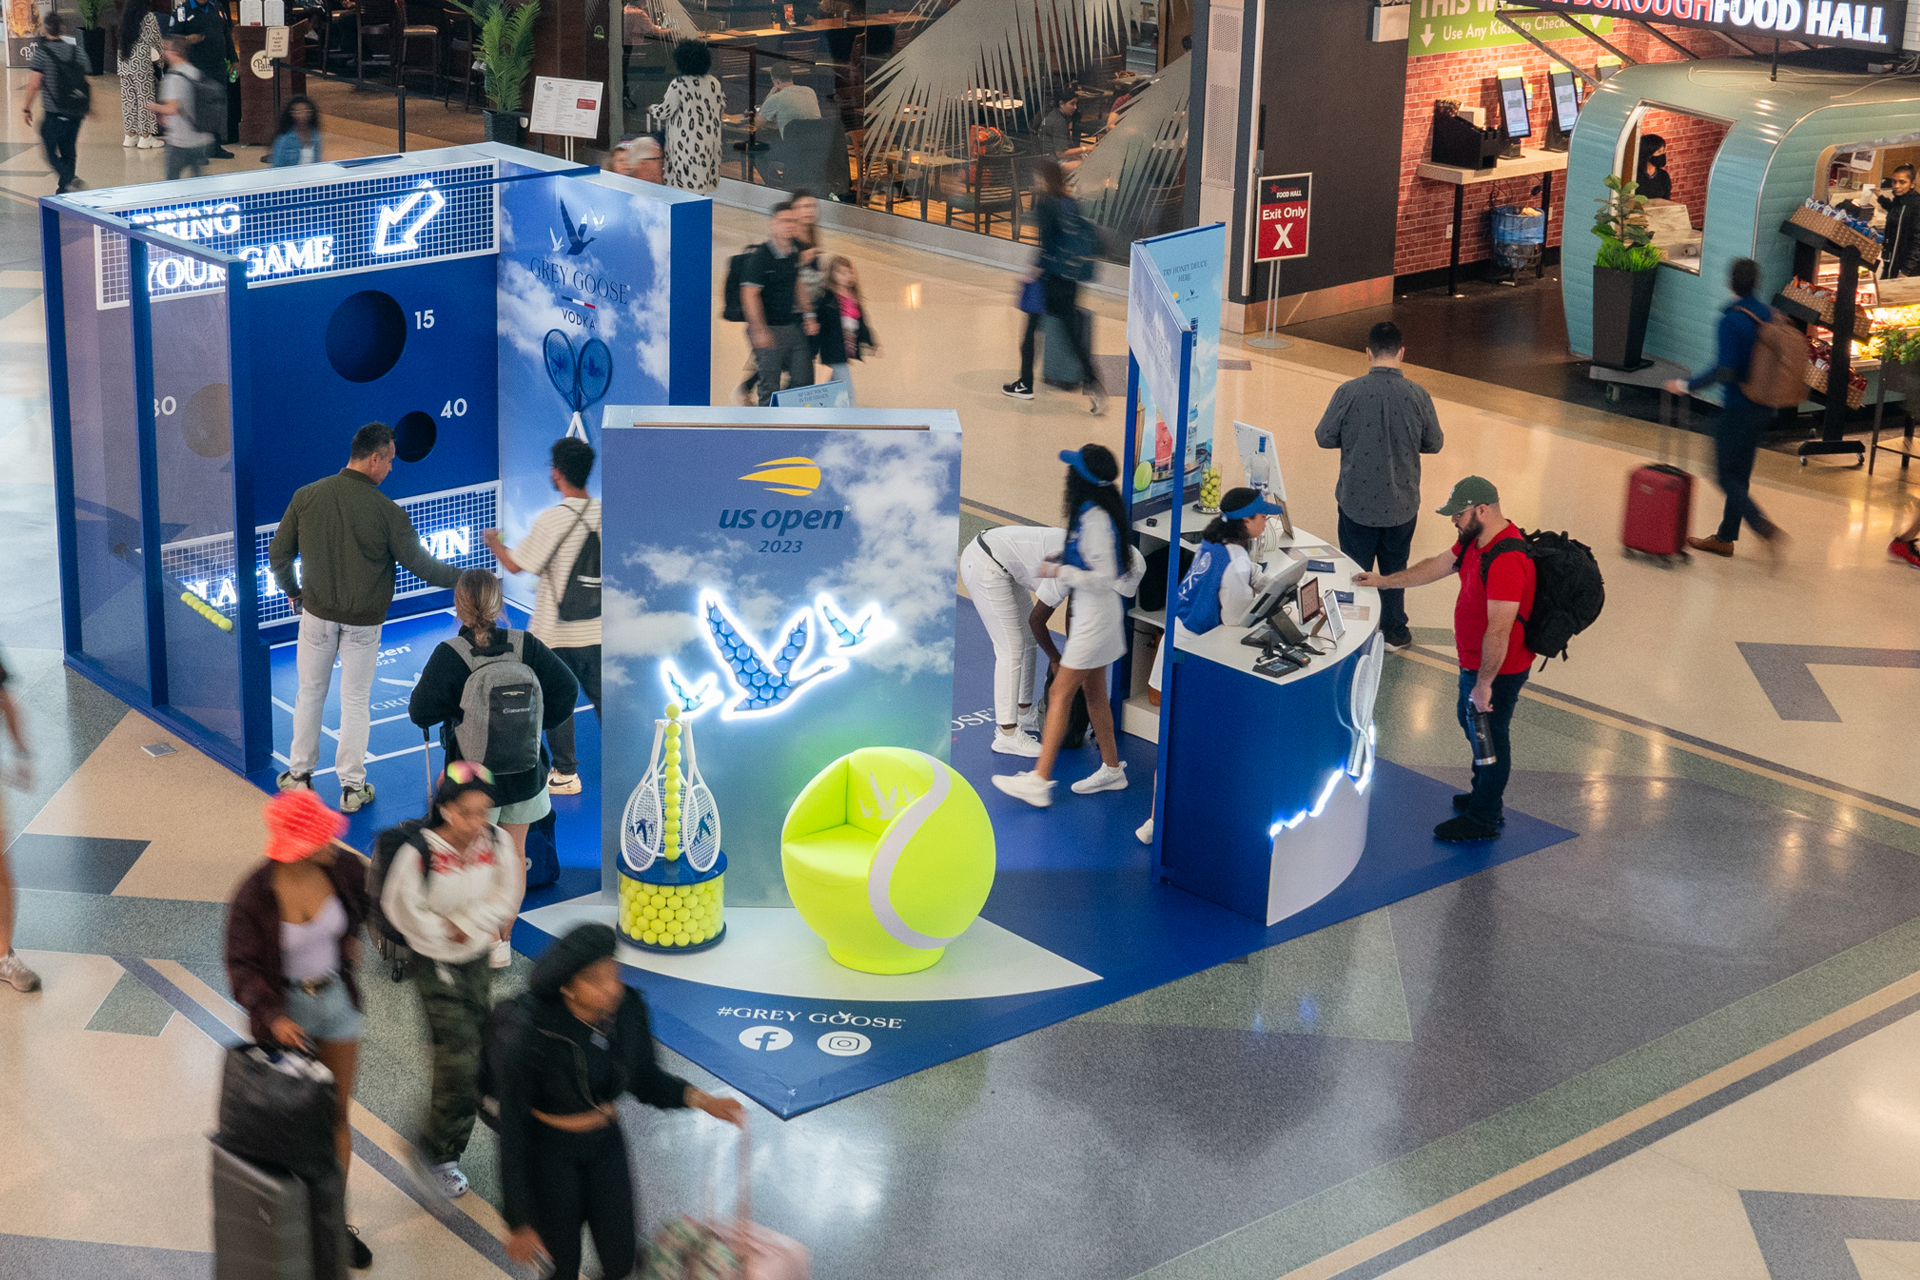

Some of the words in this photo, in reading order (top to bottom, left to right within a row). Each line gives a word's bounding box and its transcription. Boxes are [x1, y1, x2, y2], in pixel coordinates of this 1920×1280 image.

[1443, 25, 1463, 41] Use
[1465, 23, 1487, 41] Any
[1489, 19, 1516, 36] Kios
[1714, 0, 1801, 32] FOOD
[1805, 1, 1888, 44] HALL
[1276, 191, 1290, 199] FOOD
[1290, 190, 1302, 198] HALL
[132, 203, 241, 241] RING
[1262, 208, 1282, 221] Exit
[1283, 206, 1307, 219] Only
[238, 235, 334, 278] GAME
[1172, 263, 1190, 275] HONEY
[1190, 259, 1208, 270] DEUCE
[530, 256, 569, 286] GREY
[572, 270, 628, 305] GOOSE
[1177, 273, 1191, 282] HERE
[414, 309, 435, 330] 15
[561, 308, 596, 331] VODKA
[440, 398, 468, 418] 40
[718, 508, 757, 529] us
[761, 508, 844, 537] open
[758, 540, 803, 553] 2023
[376, 658, 397, 667] 023
[370, 696, 411, 711] GRE
[716, 1006, 802, 1022] #GREY
[808, 1011, 903, 1029] GOOSE
